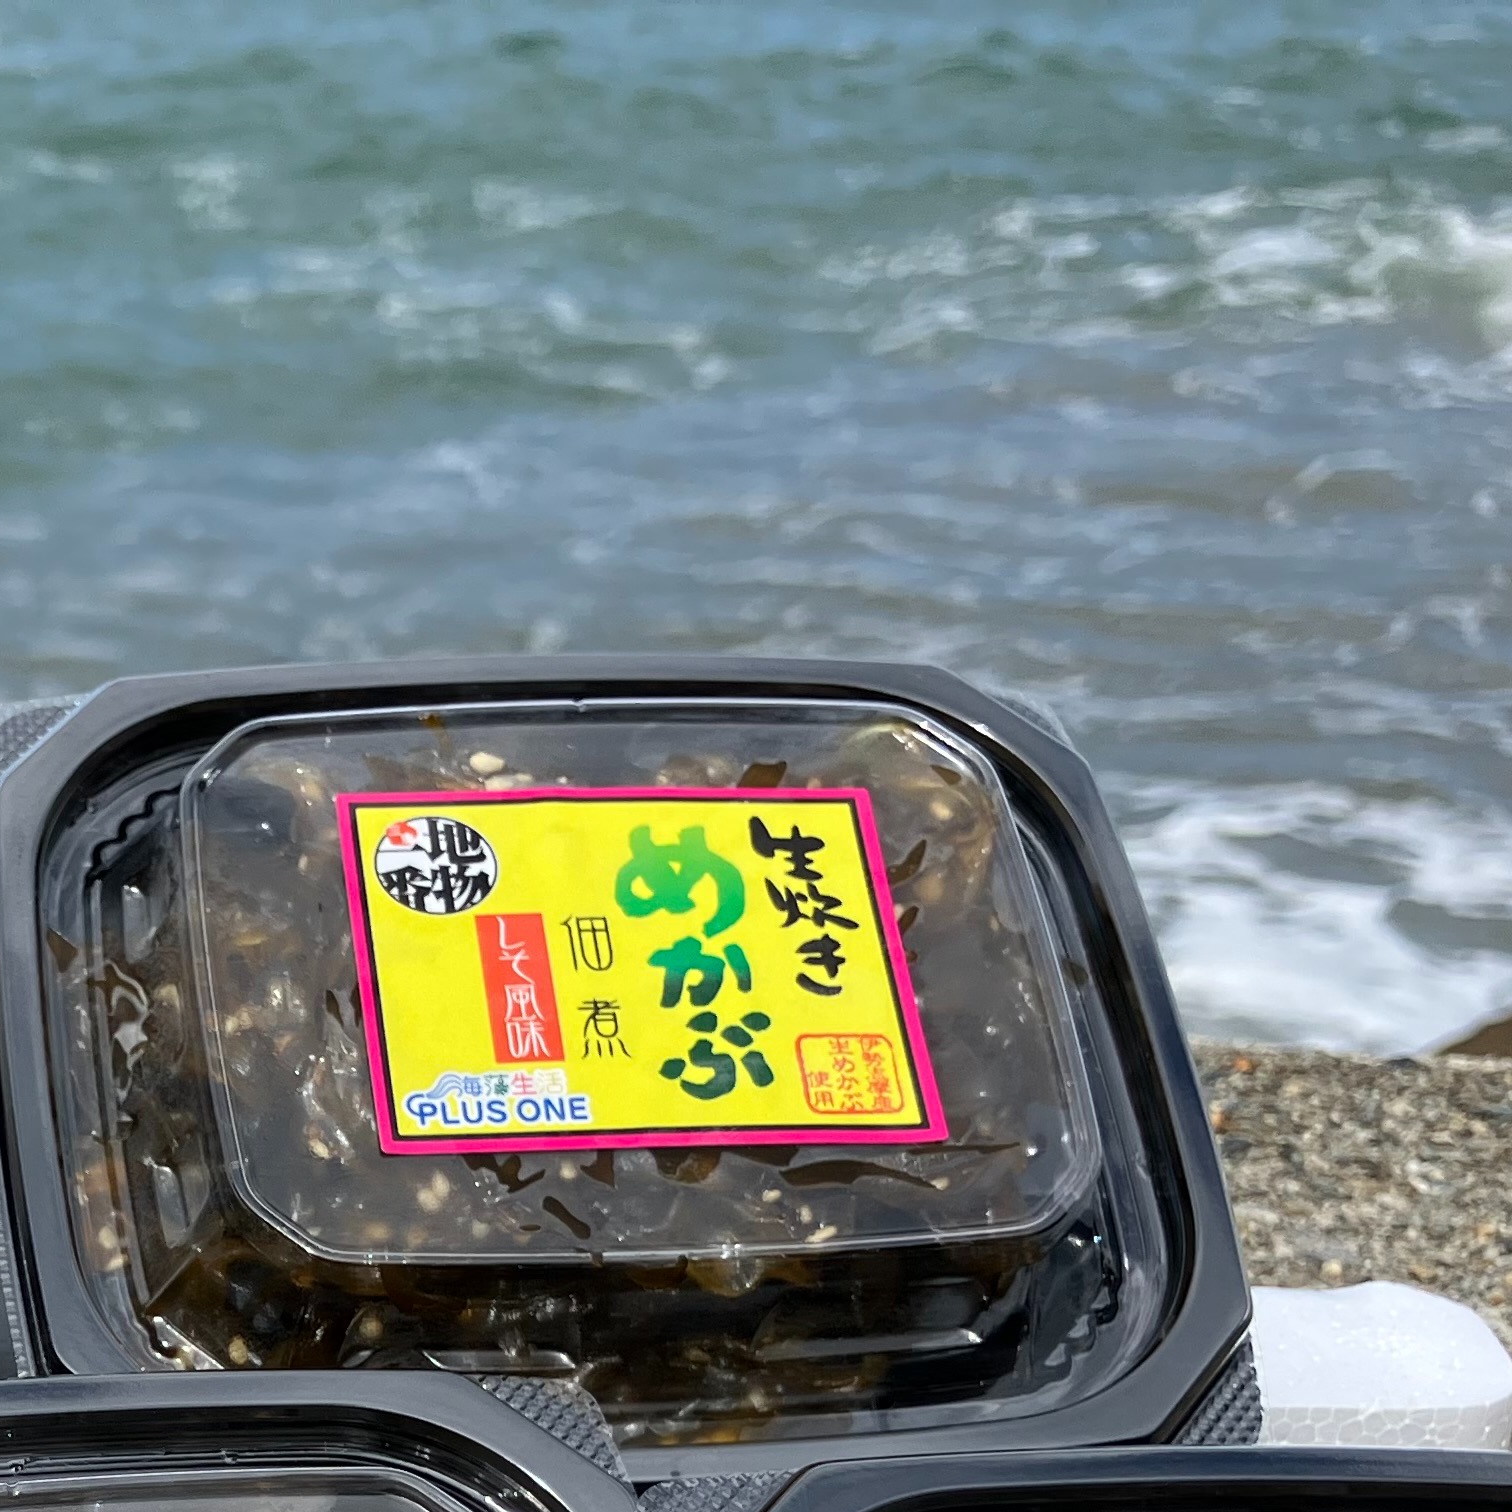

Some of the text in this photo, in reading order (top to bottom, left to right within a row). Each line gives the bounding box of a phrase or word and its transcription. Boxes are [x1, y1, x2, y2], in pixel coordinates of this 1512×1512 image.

[614, 824, 772, 1101] めかぶ
[748, 815, 859, 998] 生炊き
[496, 916, 551, 1059] しそ風味
[559, 913, 632, 1060] 佃煮
[406, 1093, 588, 1125] PLUS ONE
